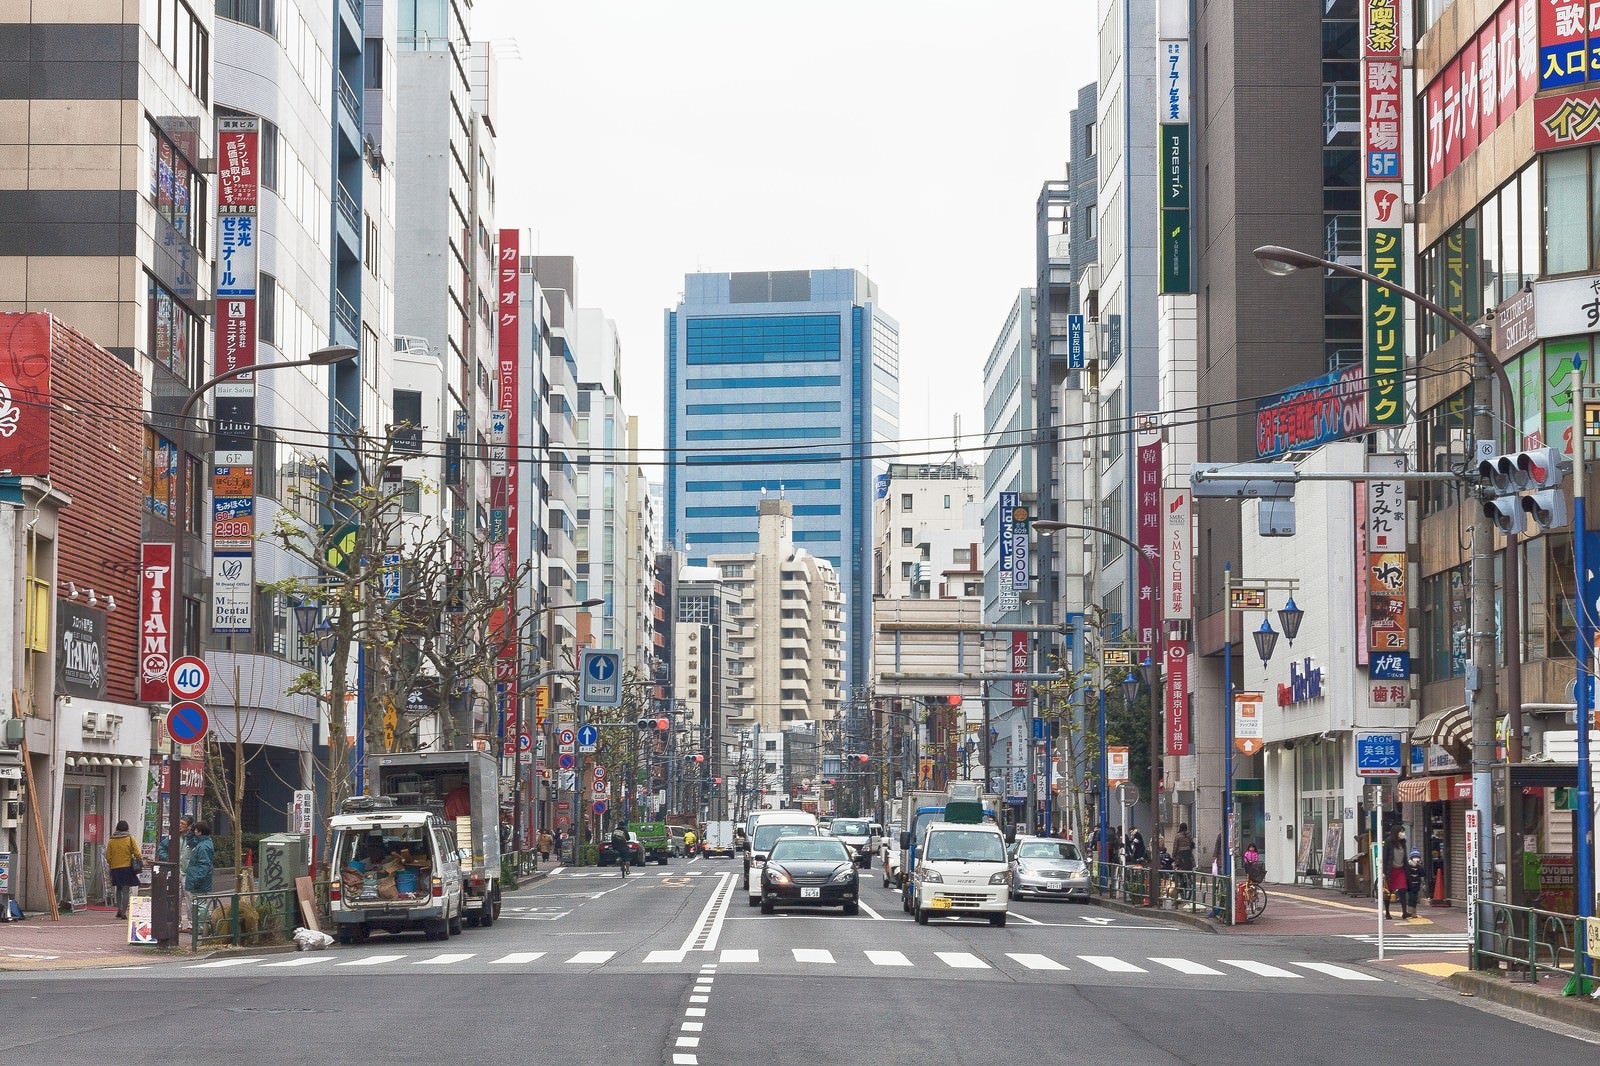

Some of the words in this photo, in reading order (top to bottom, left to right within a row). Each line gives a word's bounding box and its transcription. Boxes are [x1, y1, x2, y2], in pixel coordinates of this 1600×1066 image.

[1368, 62, 1398, 150] 歌広場
[236, 133, 251, 176] ブランド品
[1372, 153, 1396, 175] 5F
[238, 217, 252, 247] 栄光
[221, 217, 236, 286] ゼミナール
[501, 247, 517, 327] カラオケ
[239, 319, 247, 348] 株式会社
[1374, 231, 1397, 421] シティクリニック
[1506, 317, 1528, 349] SMILE
[226, 319, 237, 372] ユニオンアセッ
[501, 360, 513, 383] BIG
[226, 453, 242, 464] 6F
[216, 467, 229, 475] 3F
[1143, 449, 1158, 528] 韓国料理
[1392, 459, 1404, 521] やとり家
[216, 499, 251, 511] もみほぐし
[1371, 481, 1392, 533] すみれ
[216, 522, 250, 537] 2,980
[1015, 537, 1026, 582] 2900
[1172, 530, 1182, 613] SMBC日興証券
[216, 597, 225, 605] M
[216, 606, 249, 614] Dental
[216, 615, 247, 624] Office
[1387, 633, 1405, 646] 2F
[177, 668, 201, 688] 40
[591, 686, 611, 694] 8-17
[1372, 685, 1406, 702] 歯科
[1172, 672, 1183, 751] 三菱東京UFJ銀行
[1364, 745, 1395, 756] 英会話
[1367, 735, 1393, 743] AEON
[1361, 757, 1399, 766] イーオン
